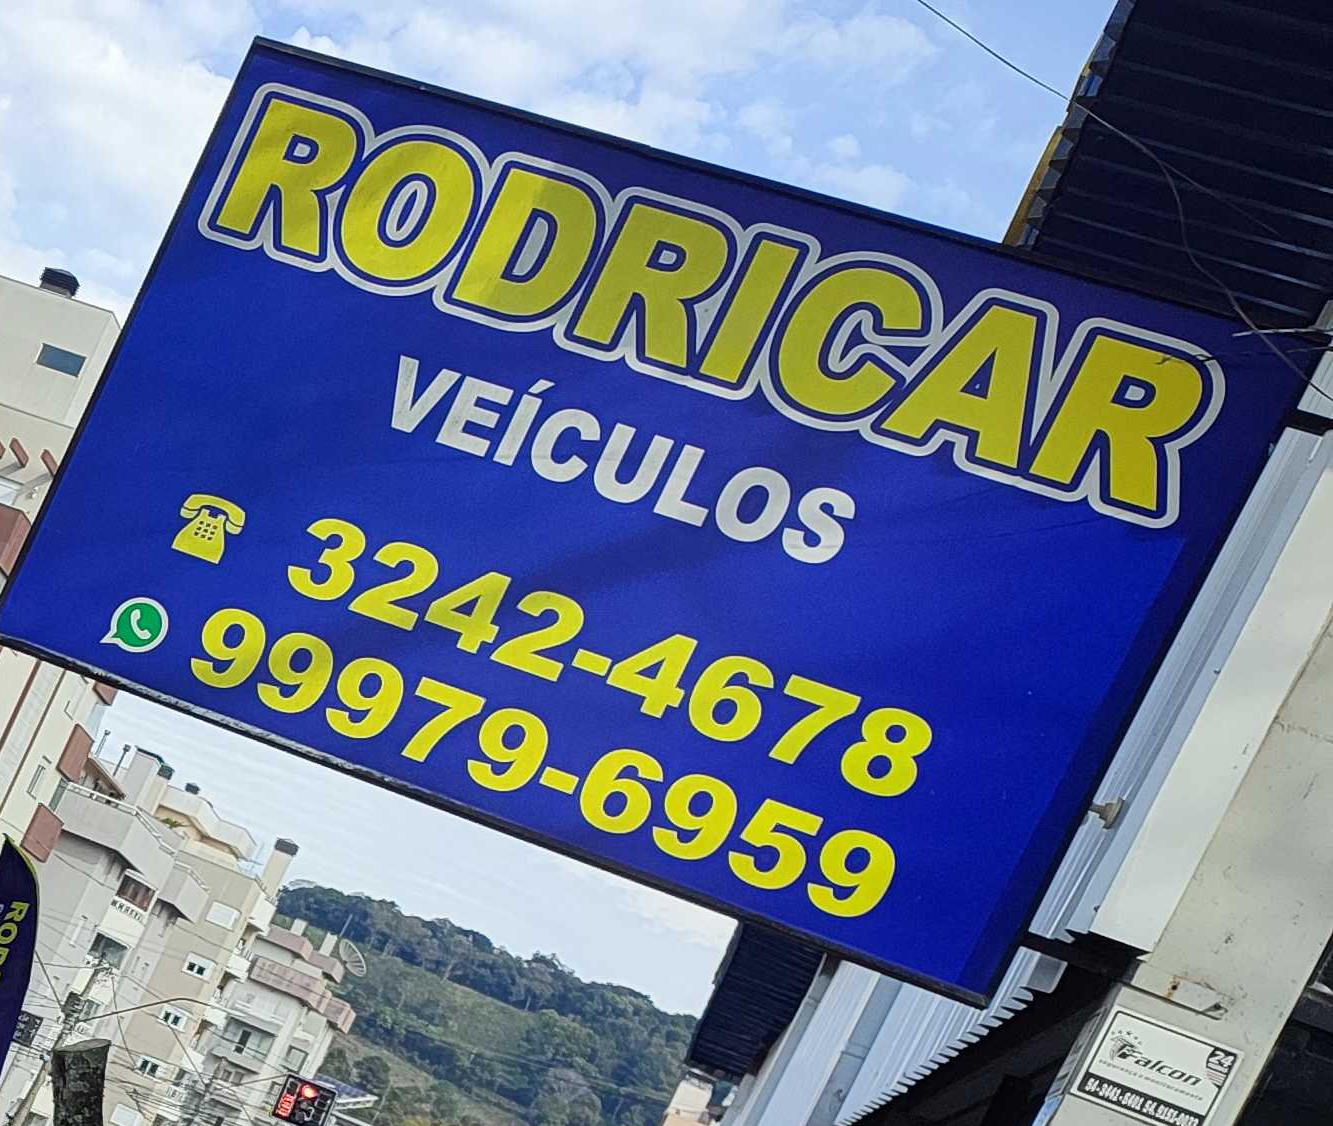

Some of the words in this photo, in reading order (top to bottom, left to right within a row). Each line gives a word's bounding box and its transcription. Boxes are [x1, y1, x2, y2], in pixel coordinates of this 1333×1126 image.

[209, 90, 1213, 516] RODRICAR
[390, 356, 855, 563] VEÍCULOS
[191, 608, 894, 916] 99979-6959
[289, 519, 931, 796] 3242-4678
[1117, 1043, 1204, 1087] Falcon
[1208, 1050, 1235, 1068] 24
